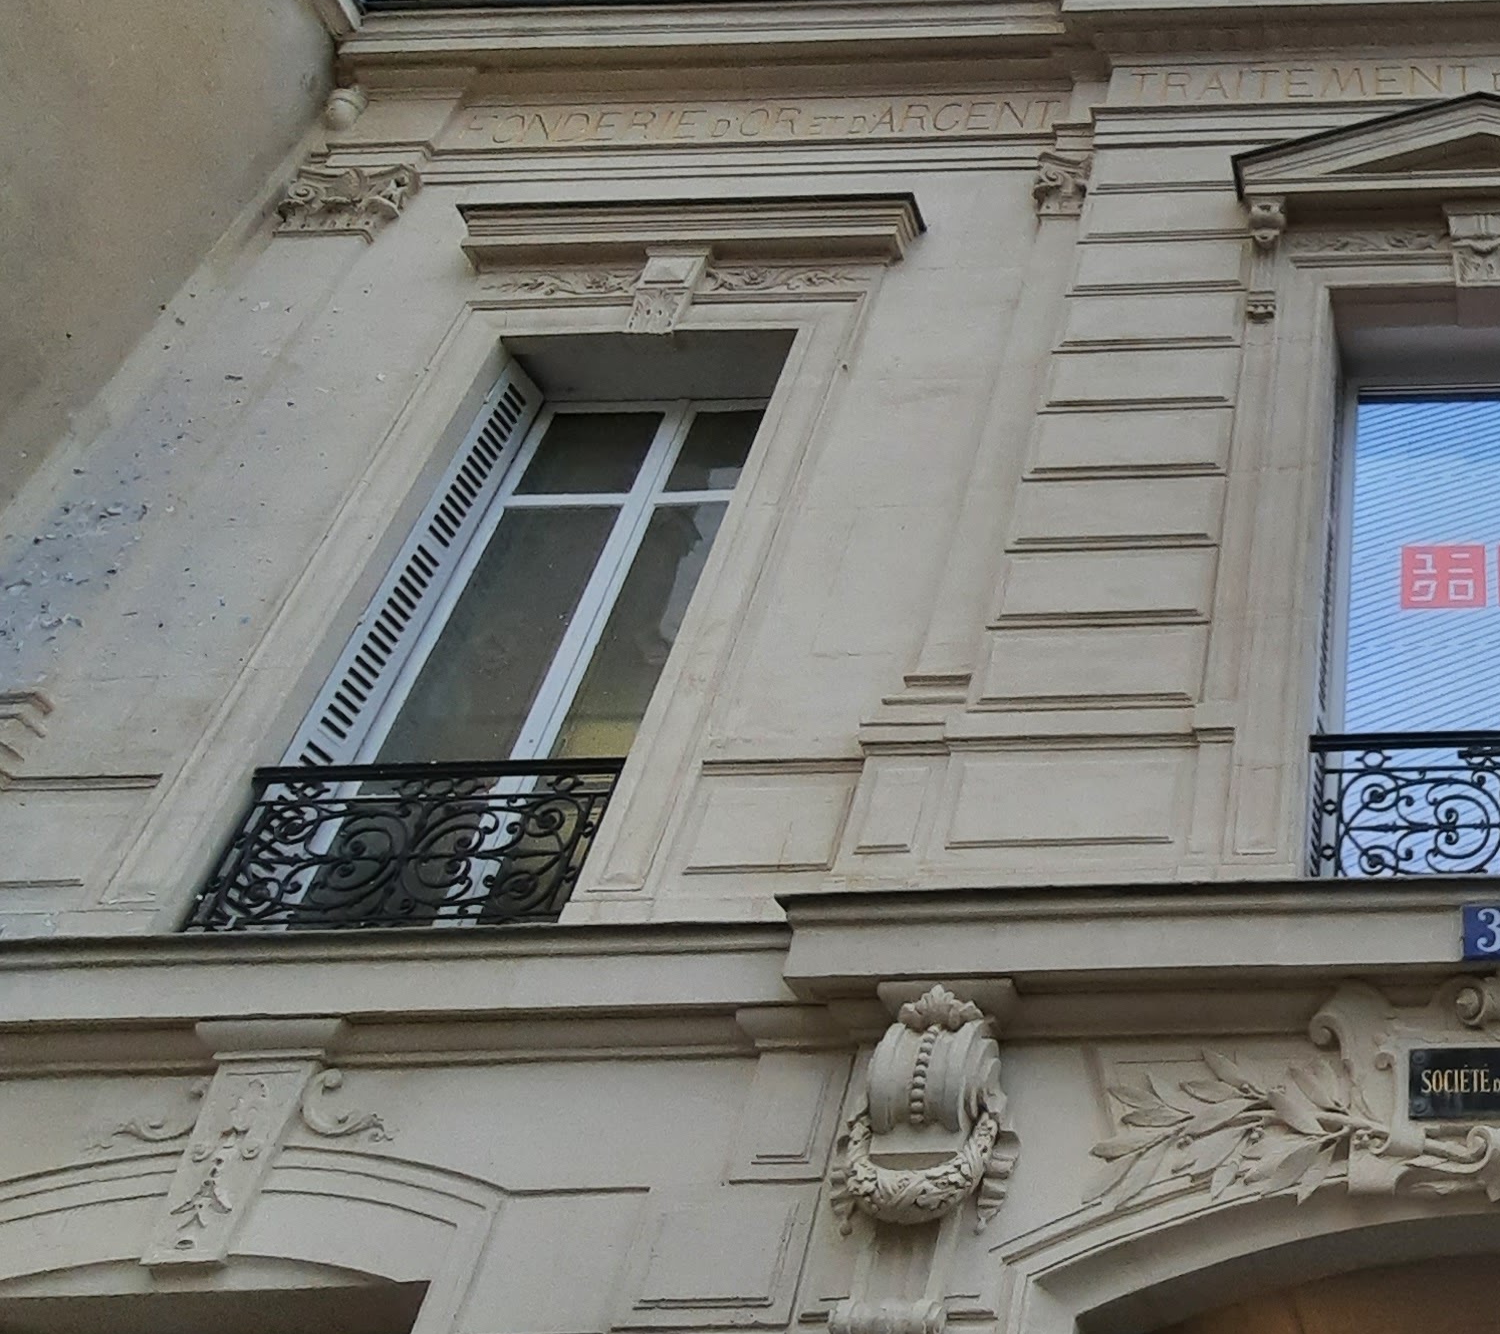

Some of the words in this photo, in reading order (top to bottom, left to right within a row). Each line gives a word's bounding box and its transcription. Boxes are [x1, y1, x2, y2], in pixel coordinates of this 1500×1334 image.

[1131, 65, 1475, 102] TRAITEMENT
[463, 110, 707, 144] FONDERIE
[1421, 1064, 1491, 1094] SOCIÉTÉ
